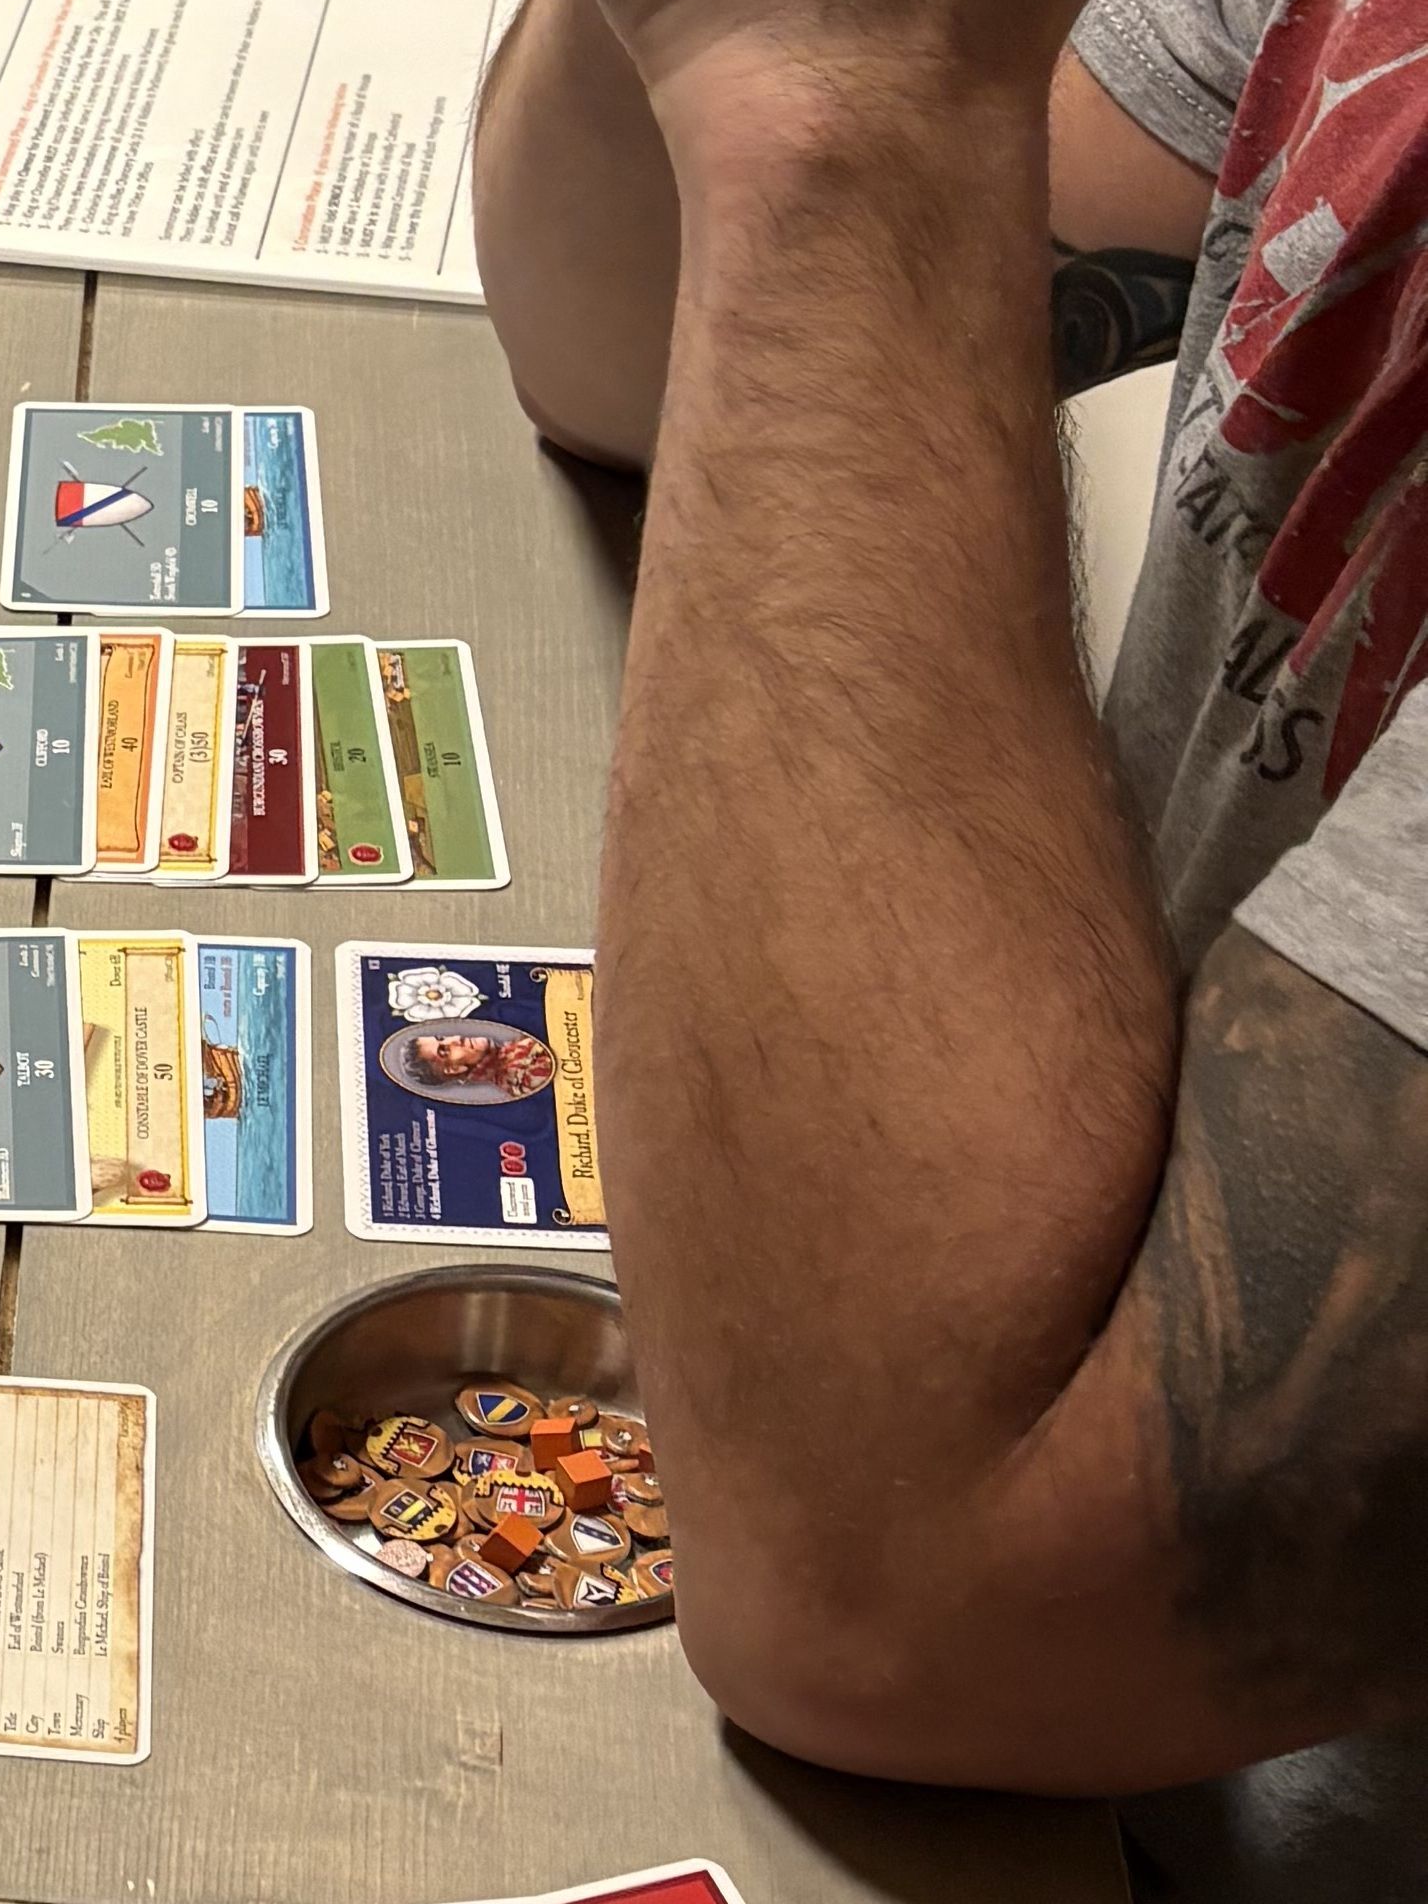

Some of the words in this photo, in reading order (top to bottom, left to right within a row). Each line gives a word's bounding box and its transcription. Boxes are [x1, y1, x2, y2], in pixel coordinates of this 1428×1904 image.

[201, 499, 219, 514] 10
[52, 739, 70, 754] 10
[121, 737, 138, 752] 40
[189, 731, 212, 763] (3)50
[268, 748, 288, 766] 30
[348, 748, 367, 763] 20
[441, 752, 462, 767] 10
[134, 1006, 148, 1039] CASTLE
[559, 1011, 583, 1074] Gloucester
[135, 1040, 149, 1070] DOVER
[16, 1051, 30, 1087] TALBOT
[35, 1060, 54, 1078] 30
[154, 1063, 173, 1081] 50
[136, 1073, 149, 1084] OF
[562, 1076, 585, 1090] of
[135, 1086, 149, 1140] CONSTABLE
[565, 1092, 590, 1126] Duke
[568, 1129, 595, 1179] Richard,
